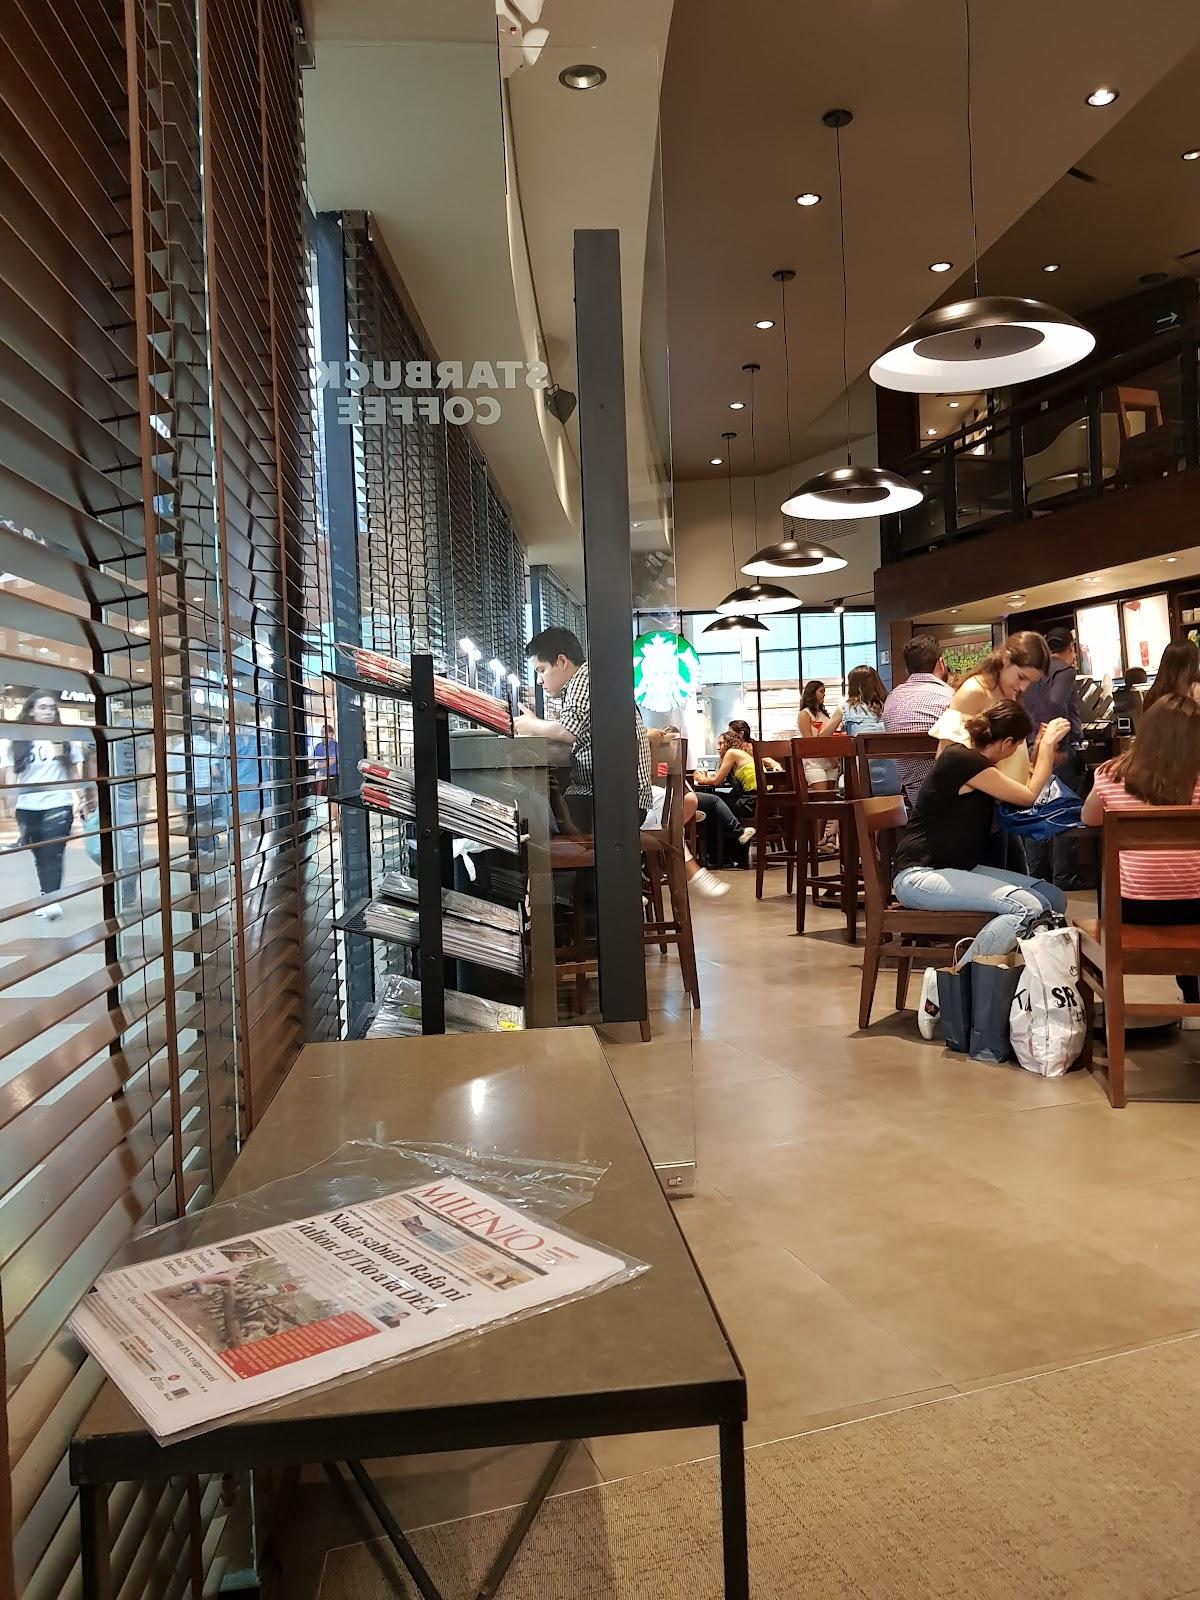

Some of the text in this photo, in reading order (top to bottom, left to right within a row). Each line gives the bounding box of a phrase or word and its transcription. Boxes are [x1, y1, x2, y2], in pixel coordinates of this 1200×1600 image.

[412, 1184, 545, 1251] MILENIO
[324, 1213, 362, 1240] Nada
[357, 1238, 411, 1267] sabían
[403, 1263, 447, 1291] Rafa
[440, 1287, 472, 1302] ni
[334, 1249, 361, 1262] El
[349, 1257, 381, 1276] Tío
[371, 1271, 386, 1283] a
[394, 1289, 440, 1316] DEA
